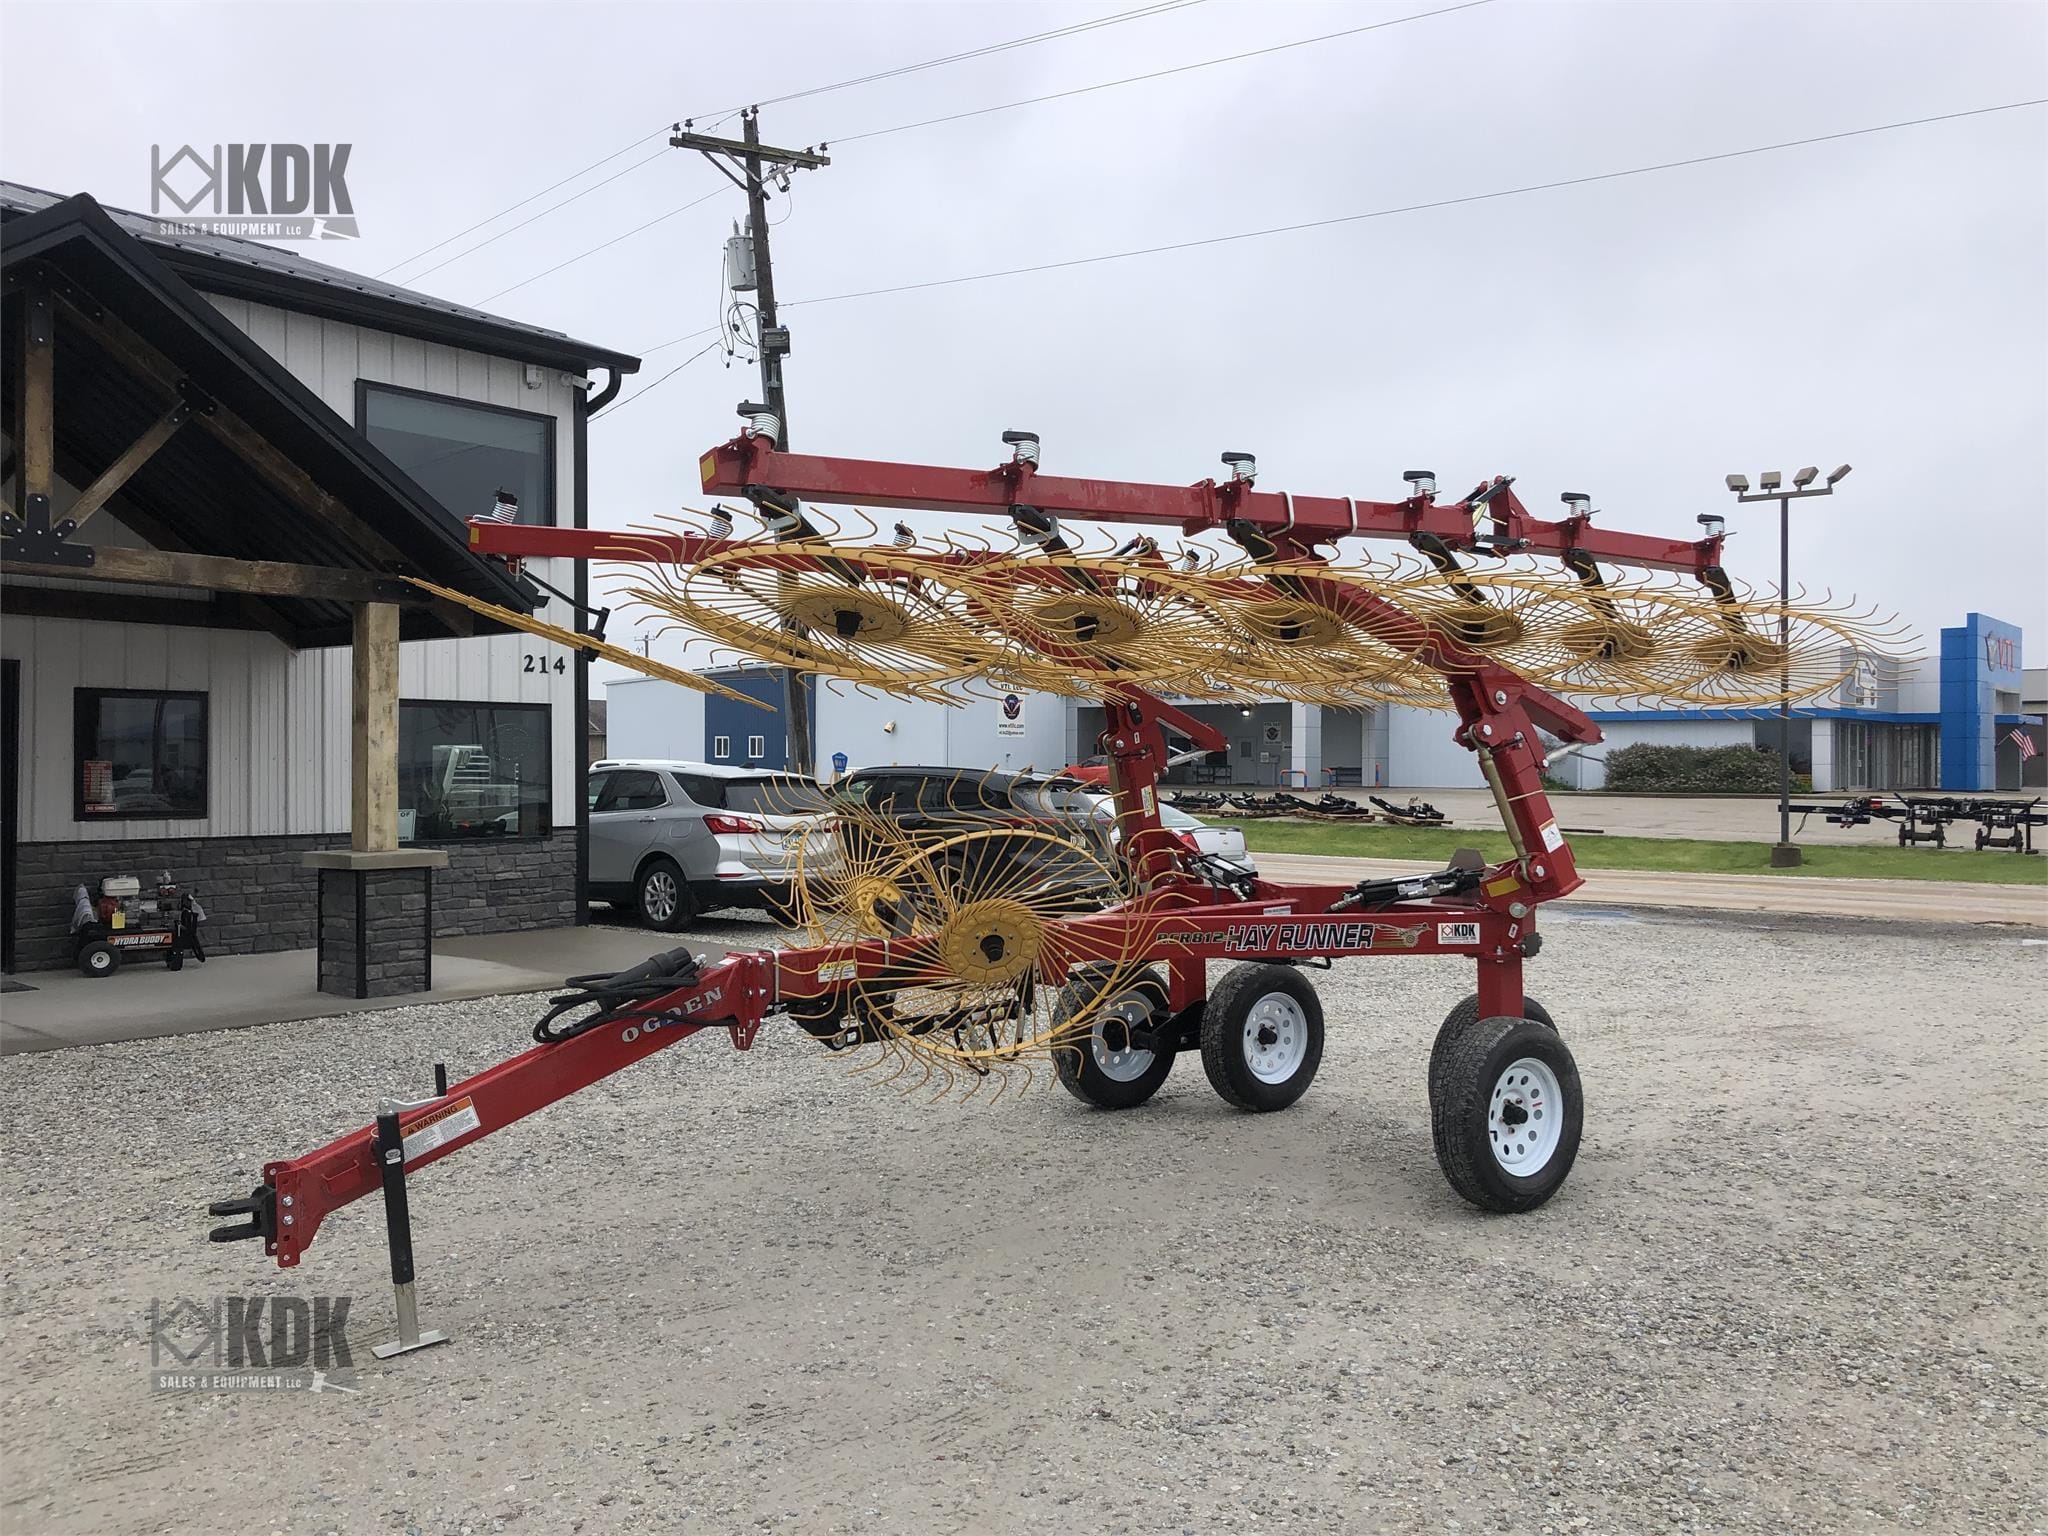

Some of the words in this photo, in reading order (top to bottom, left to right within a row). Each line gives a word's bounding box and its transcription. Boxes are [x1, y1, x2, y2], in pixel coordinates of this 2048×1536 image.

[523, 654, 566, 675] 214
[113, 936, 139, 946] HYDRA
[139, 935, 166, 945] BUDDY
[1225, 924, 1278, 952] HAY
[1277, 922, 1376, 951] RUNNER
[1454, 924, 1476, 937] KDK
[415, 1105, 458, 1129] WARNING
